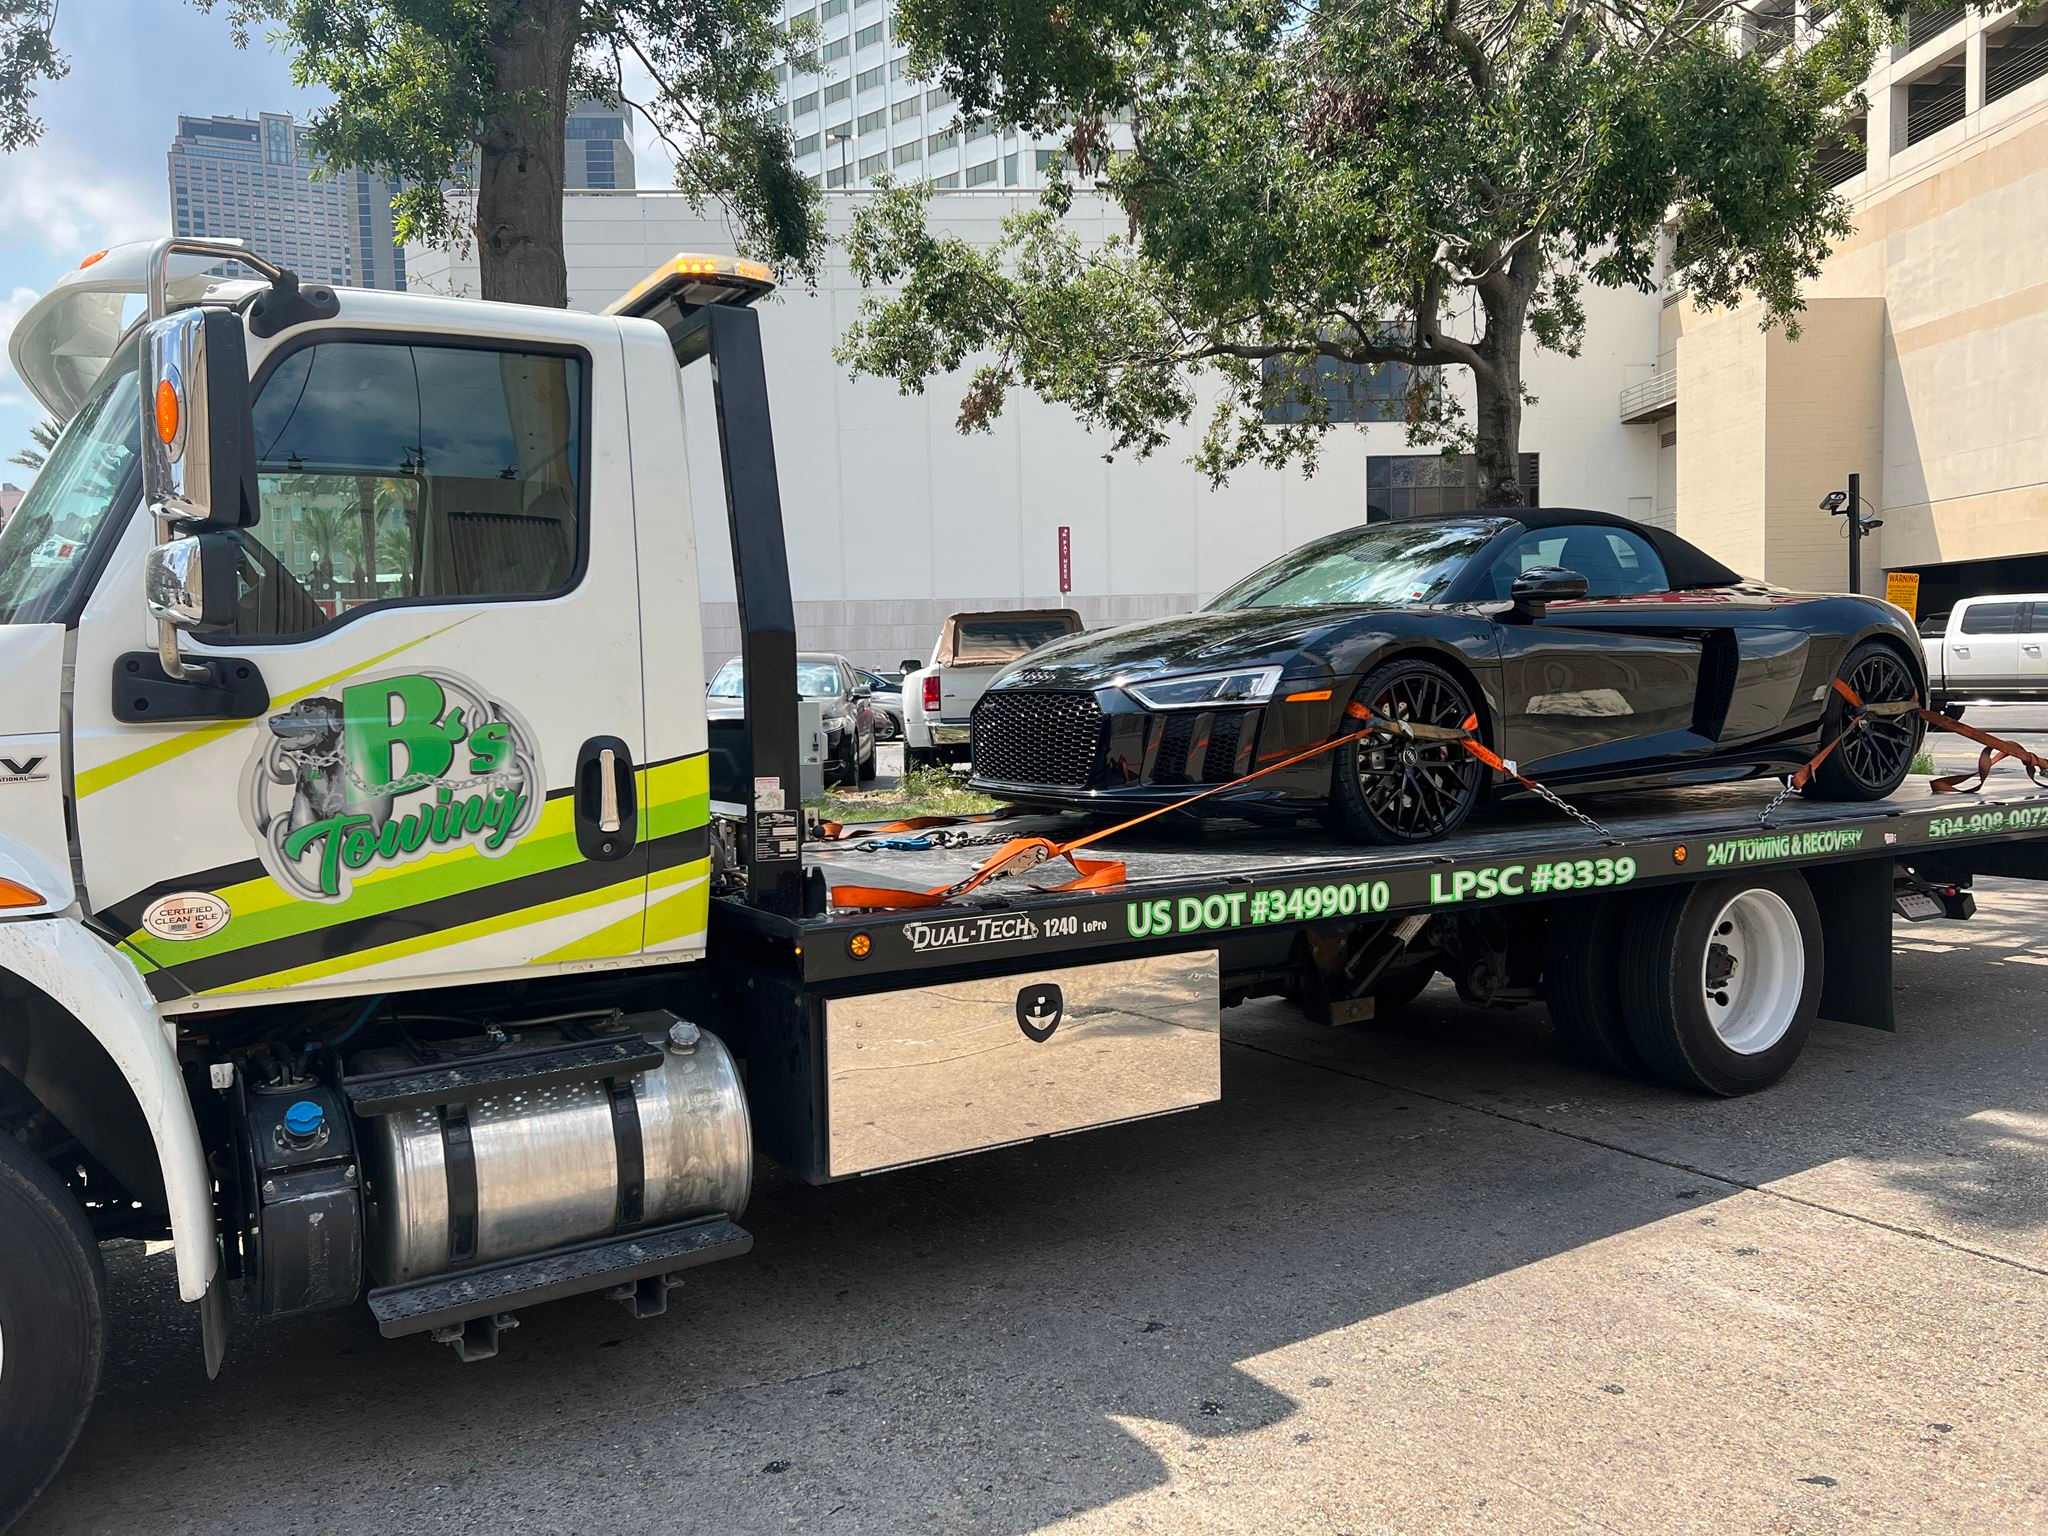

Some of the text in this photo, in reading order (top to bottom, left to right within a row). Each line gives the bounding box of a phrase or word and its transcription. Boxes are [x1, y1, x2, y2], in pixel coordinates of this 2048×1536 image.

[1890, 575, 1918, 583] WARNING
[342, 673, 518, 798] B's
[1928, 806, 2048, 838] 504-908-0072
[282, 787, 527, 896] Towing
[1706, 840, 1737, 866] 24/7
[1738, 835, 1790, 862] TOWING
[1791, 833, 1802, 856] &
[1803, 828, 1863, 854] RECOVERY
[1430, 856, 1637, 904] LPSC #8339
[155, 913, 218, 925] CLEAN IDLE
[160, 906, 212, 916] CERTIFIED
[1043, 915, 1078, 938] 1240
[1082, 920, 1108, 933] LoPro
[1127, 880, 1391, 938] US DOT #3499010
